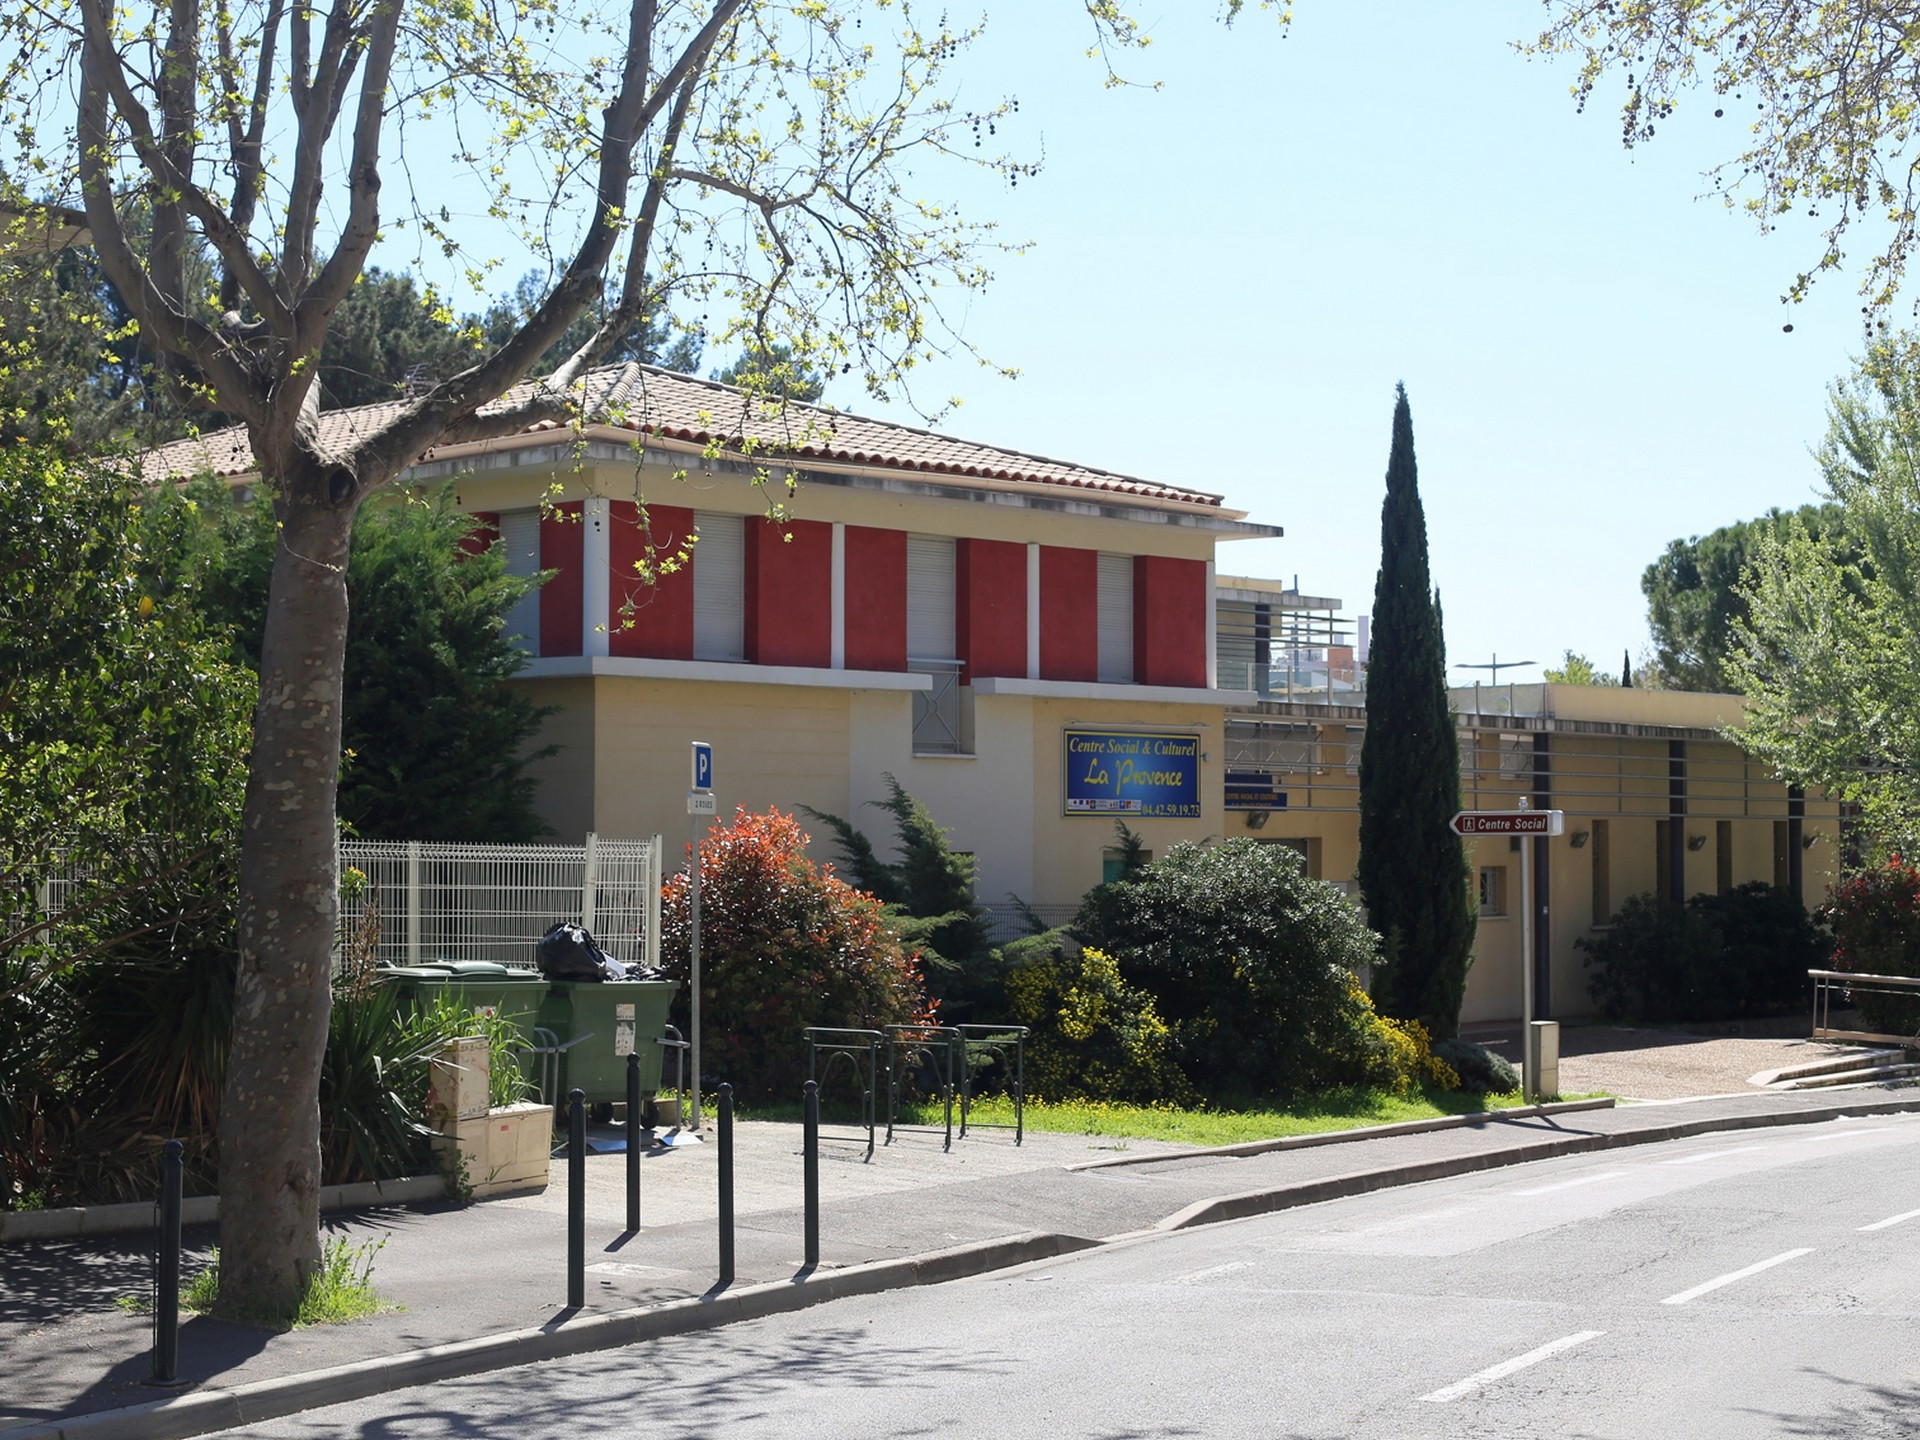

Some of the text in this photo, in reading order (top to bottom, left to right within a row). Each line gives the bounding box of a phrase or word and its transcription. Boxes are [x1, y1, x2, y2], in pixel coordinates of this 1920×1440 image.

[1070, 737, 1196, 756] Centre Social & Culturel
[700, 753, 708, 781] P
[1084, 757, 1183, 795] La Provence
[1143, 804, 1201, 817] 04.42.59.19.73
[1478, 818, 1546, 830] Centre Social
